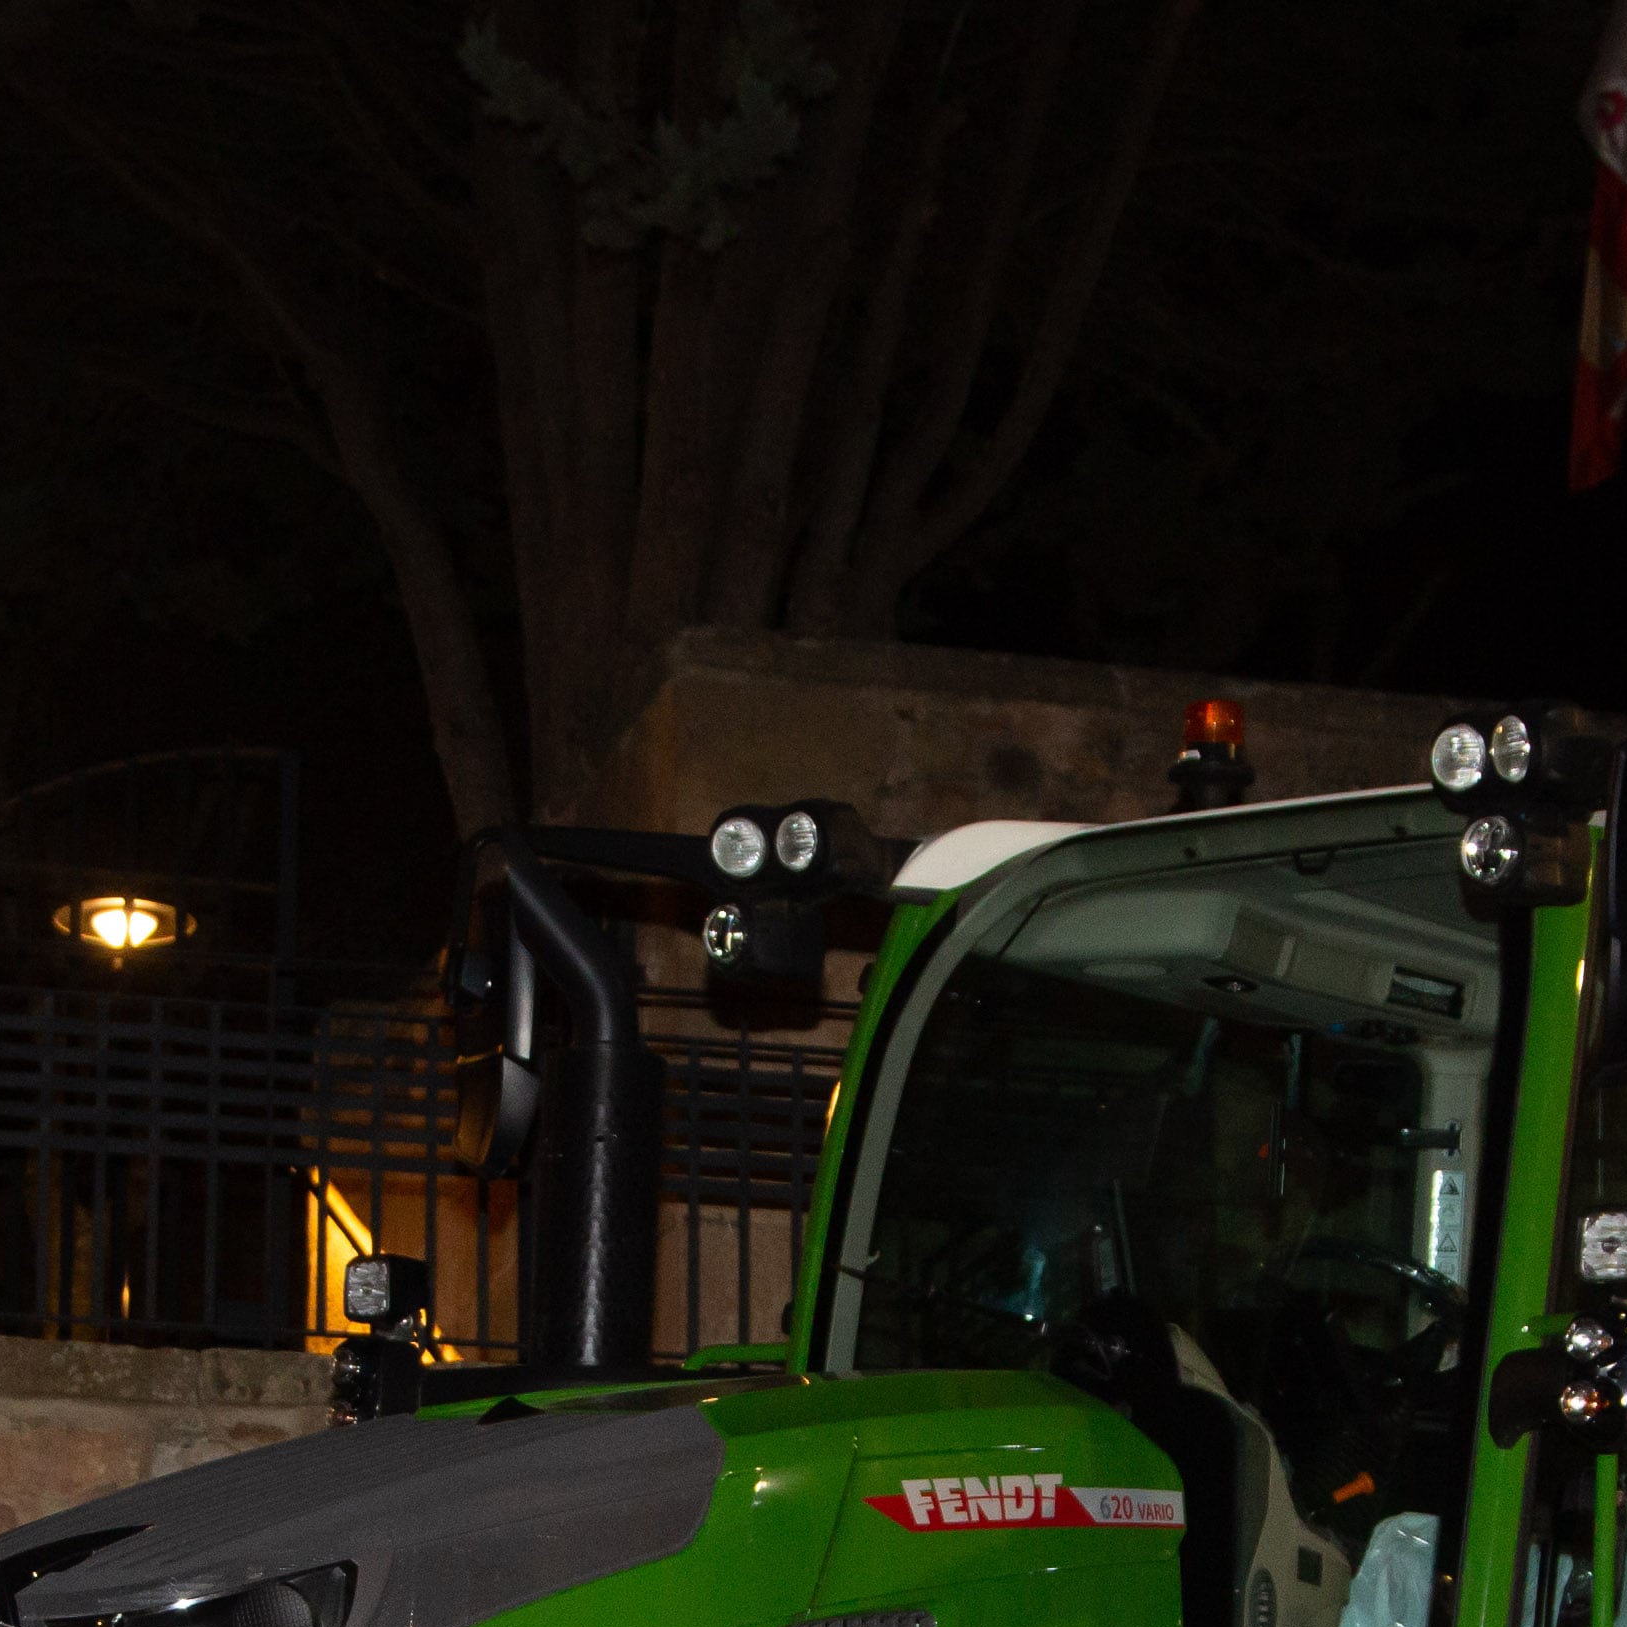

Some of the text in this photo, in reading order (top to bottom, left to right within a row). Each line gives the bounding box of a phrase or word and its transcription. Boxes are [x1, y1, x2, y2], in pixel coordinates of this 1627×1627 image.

[901, 1473, 1175, 1526] FENDT 620 VARIO
